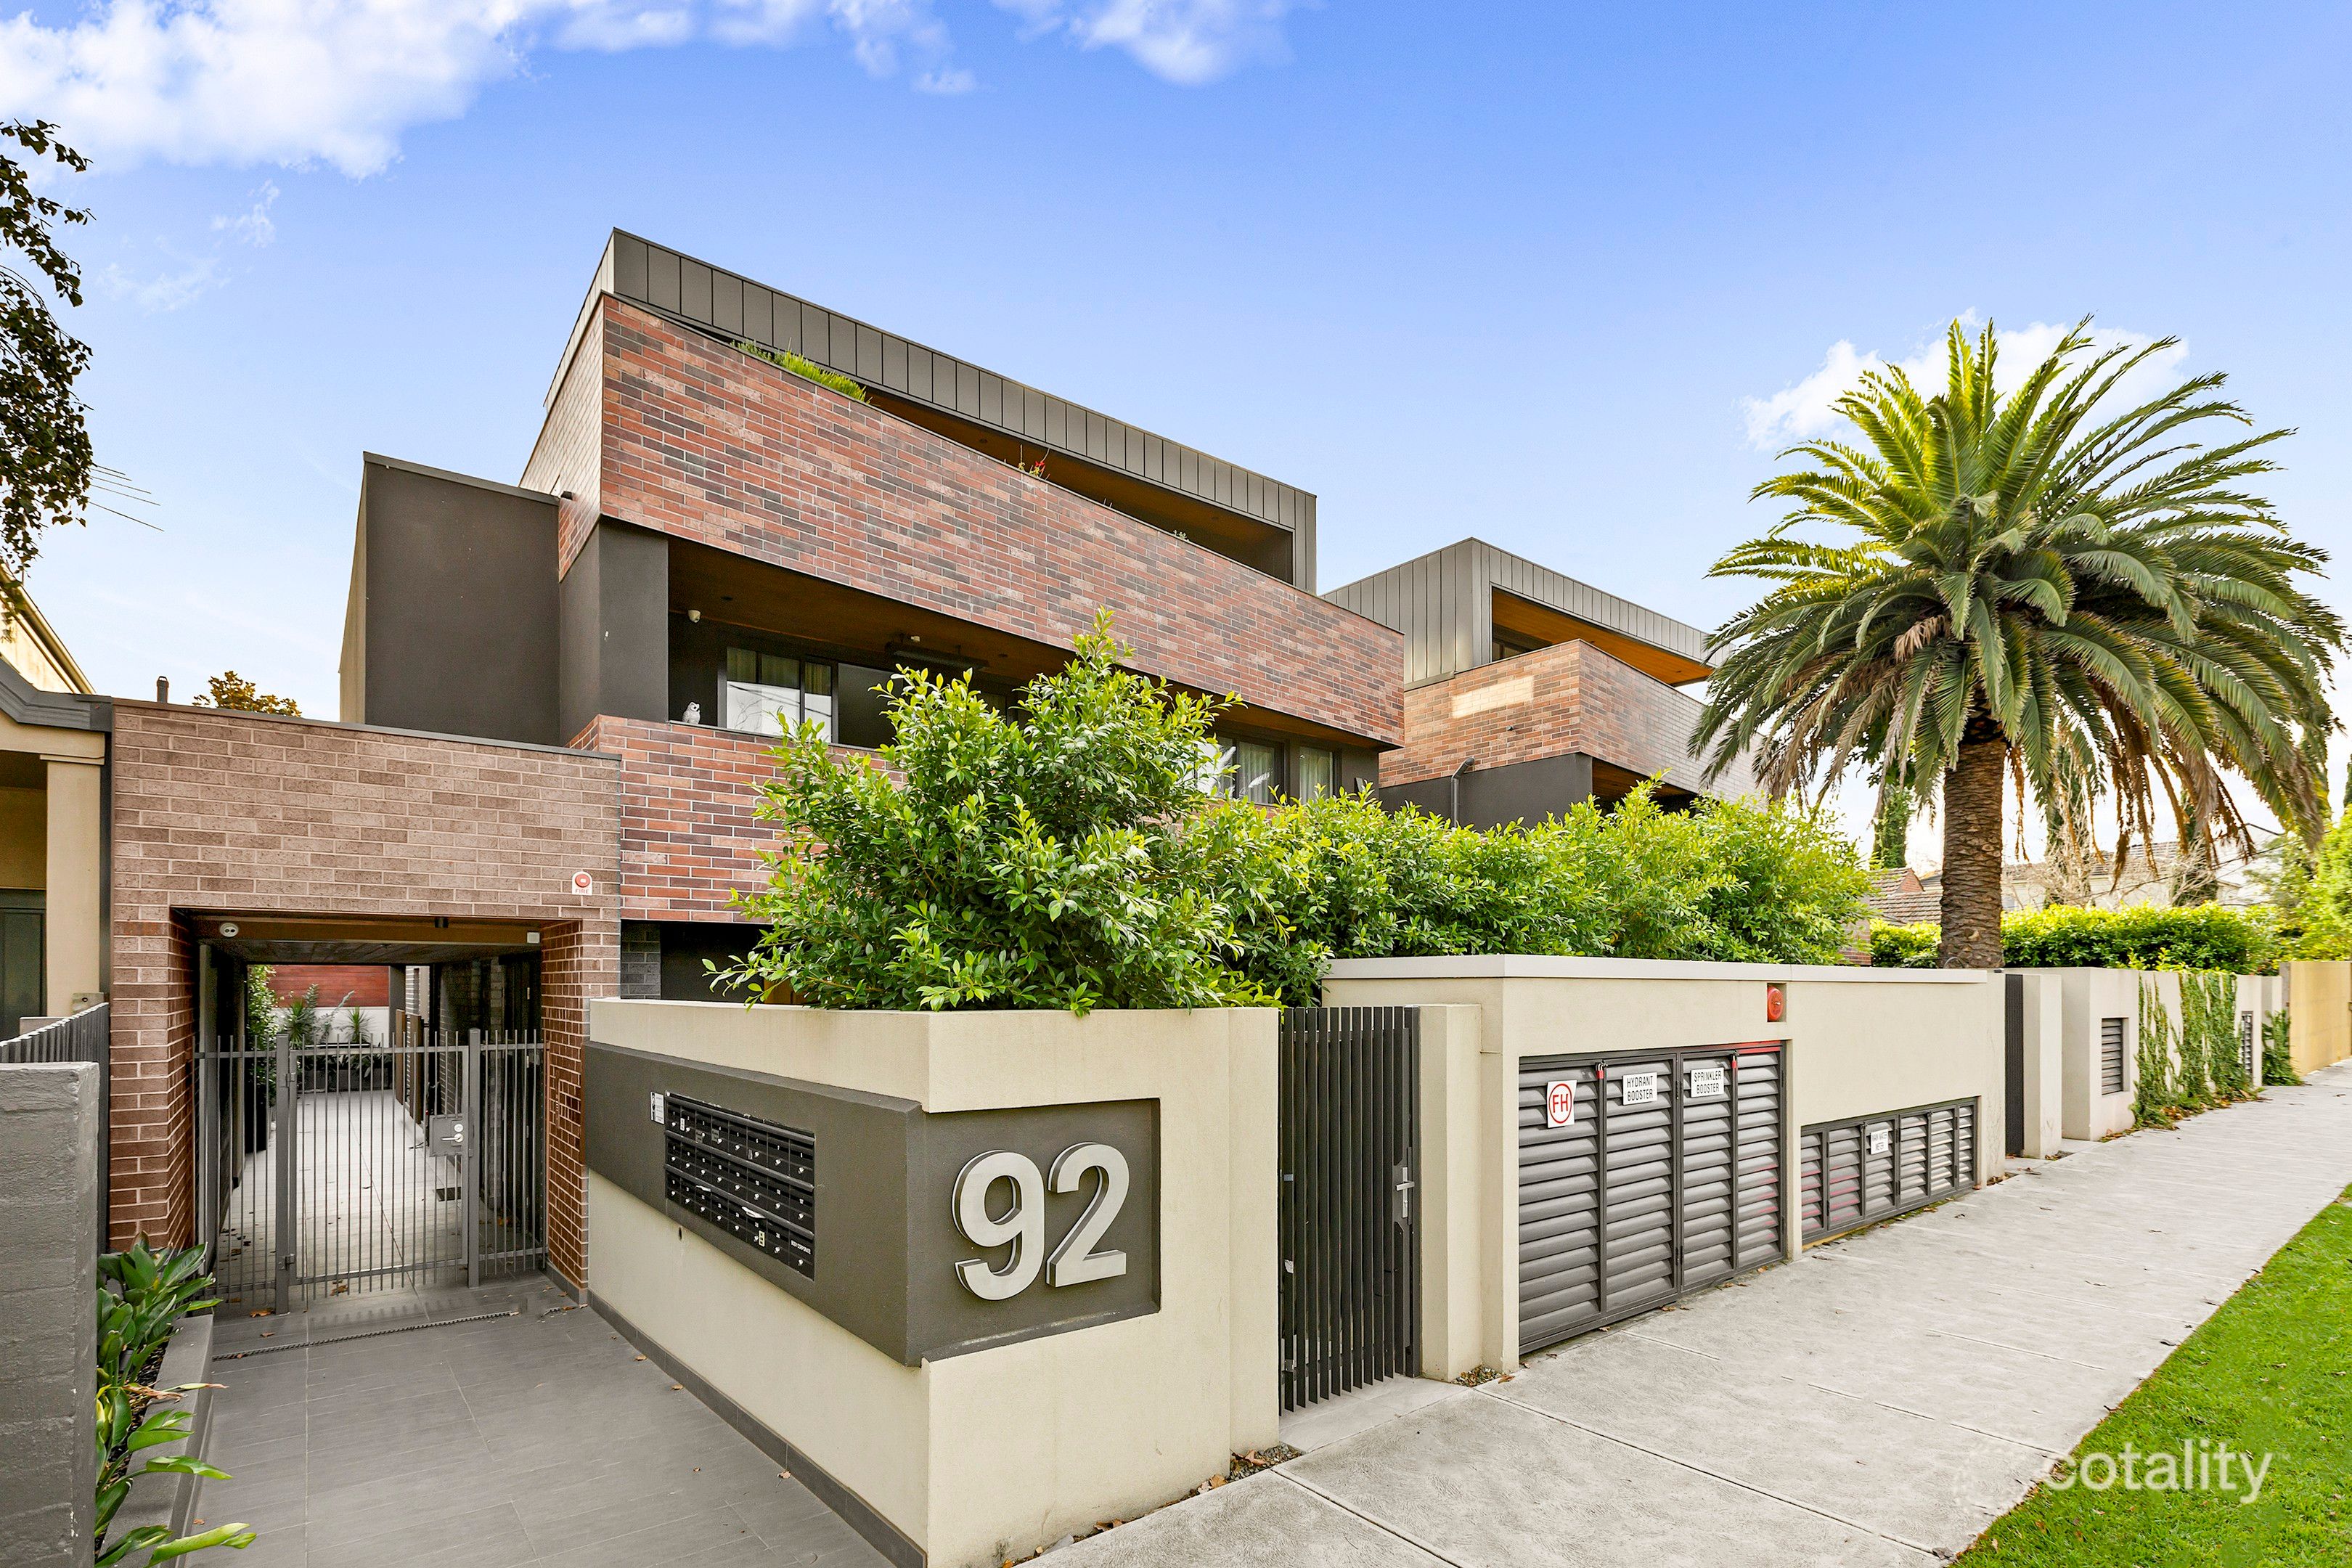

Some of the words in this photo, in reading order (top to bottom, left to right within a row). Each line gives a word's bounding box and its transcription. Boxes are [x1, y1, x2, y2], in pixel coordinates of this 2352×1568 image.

[1627, 1075, 1654, 1087] HYDRANT
[1694, 1070, 1722, 1082] SPRINKLER
[1696, 1082, 1720, 1094] BOOSTER
[1627, 1089, 1654, 1101] BOOSTER
[1552, 1093, 1569, 1113] FH
[952, 1141, 1130, 1301] 92
